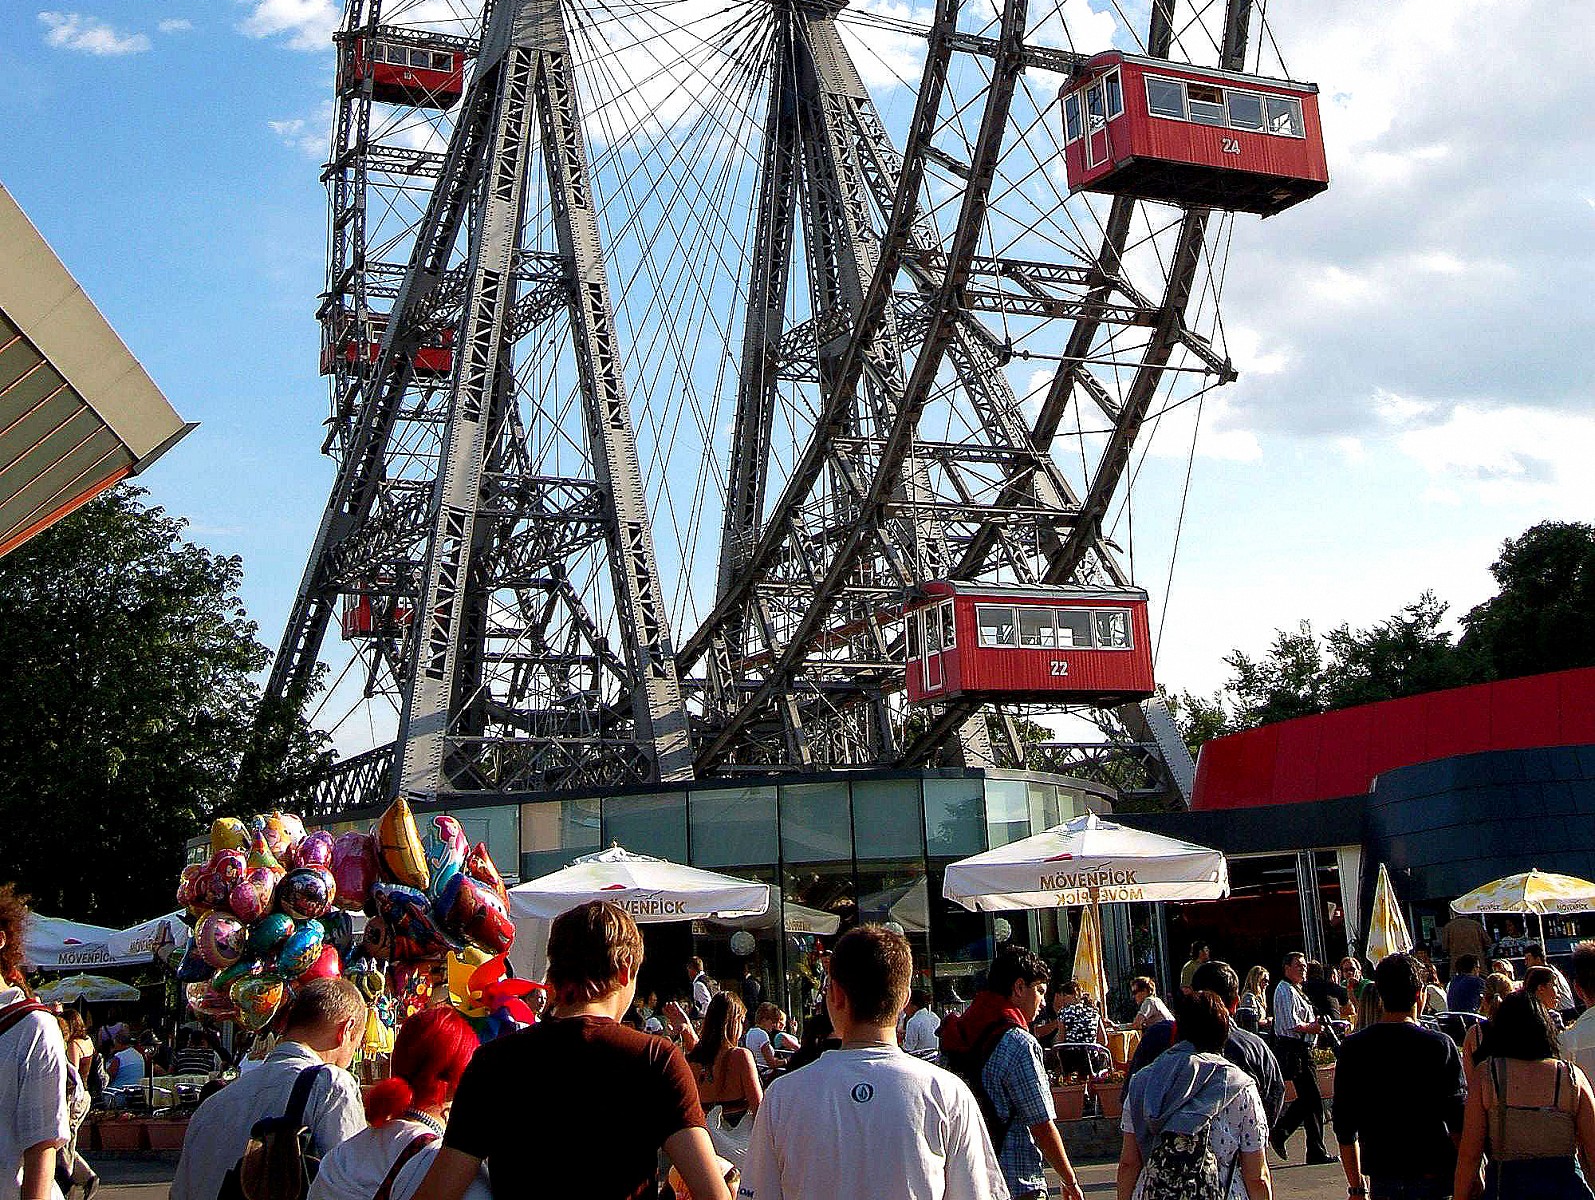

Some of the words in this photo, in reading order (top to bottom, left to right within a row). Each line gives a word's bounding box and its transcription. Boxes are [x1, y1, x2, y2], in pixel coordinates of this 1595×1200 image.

[1222, 138, 1240, 155] 24
[1050, 661, 1068, 676] 22
[1040, 868, 1138, 890] MÖVENPICK
